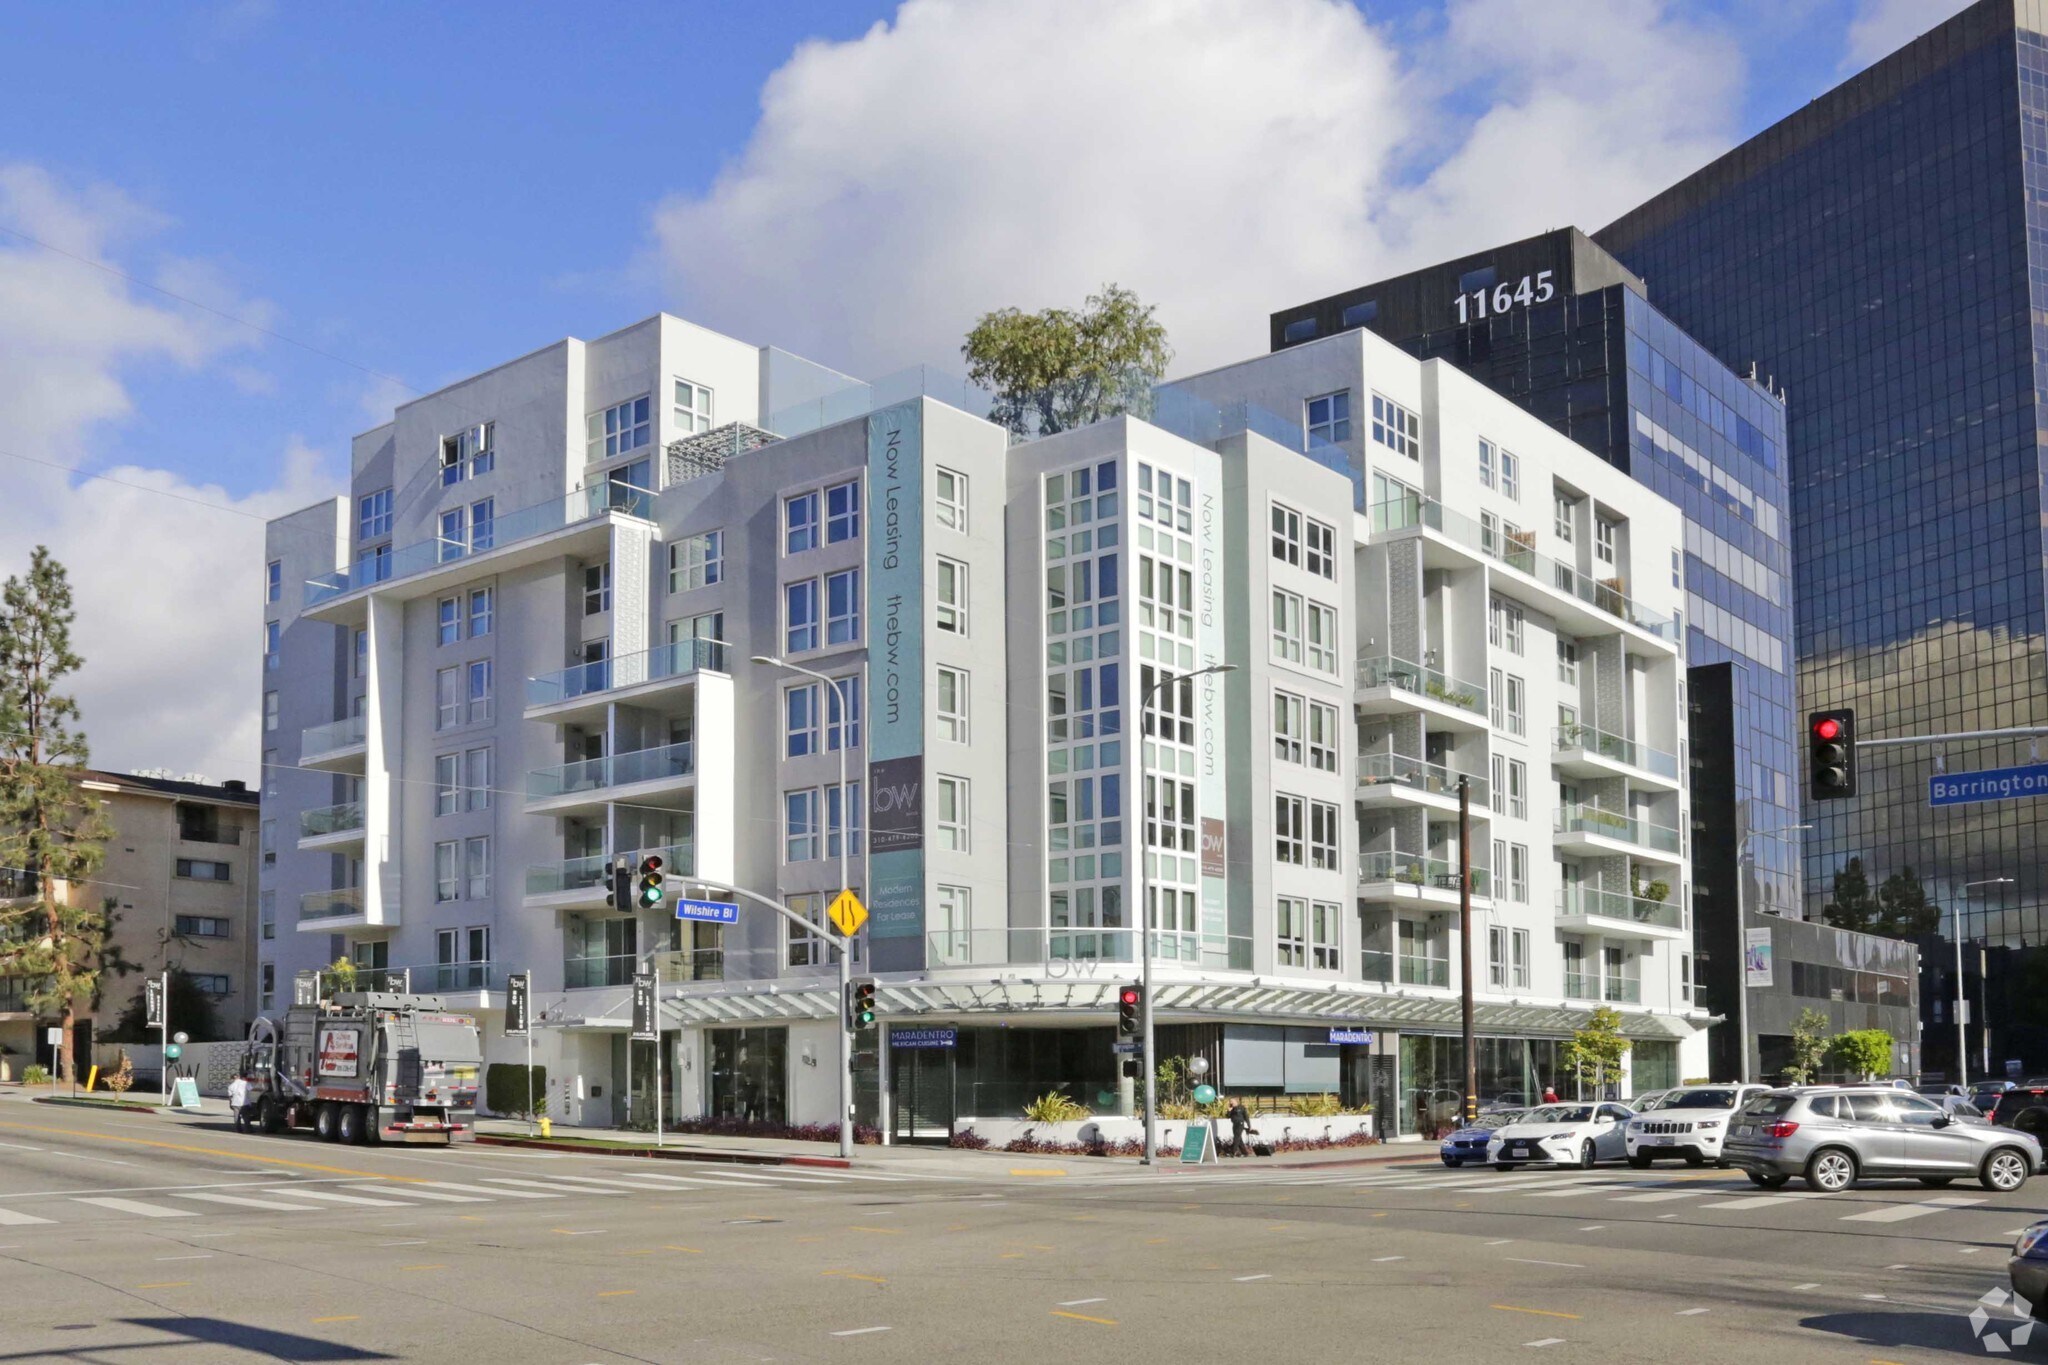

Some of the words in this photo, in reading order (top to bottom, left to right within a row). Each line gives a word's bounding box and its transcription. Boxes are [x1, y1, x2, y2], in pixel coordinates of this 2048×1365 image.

[1454, 270, 1554, 324] 11645
[887, 429, 901, 480] Now
[883, 486, 902, 570] Leasing
[1201, 493, 1214, 542] Now
[1200, 549, 1215, 628] Leasing
[886, 595, 902, 724] thebw.com
[1934, 774, 2048, 798] Barrington
[880, 884, 912, 896] Modern
[684, 904, 720, 918] Wilshire
[723, 907, 733, 919] Bl
[873, 898, 920, 908] Residences
[877, 912, 889, 921] For
[890, 911, 915, 921] Lease
[892, 1030, 954, 1040] MARADENTRO
[1330, 1032, 1374, 1043] MARADENTRO
